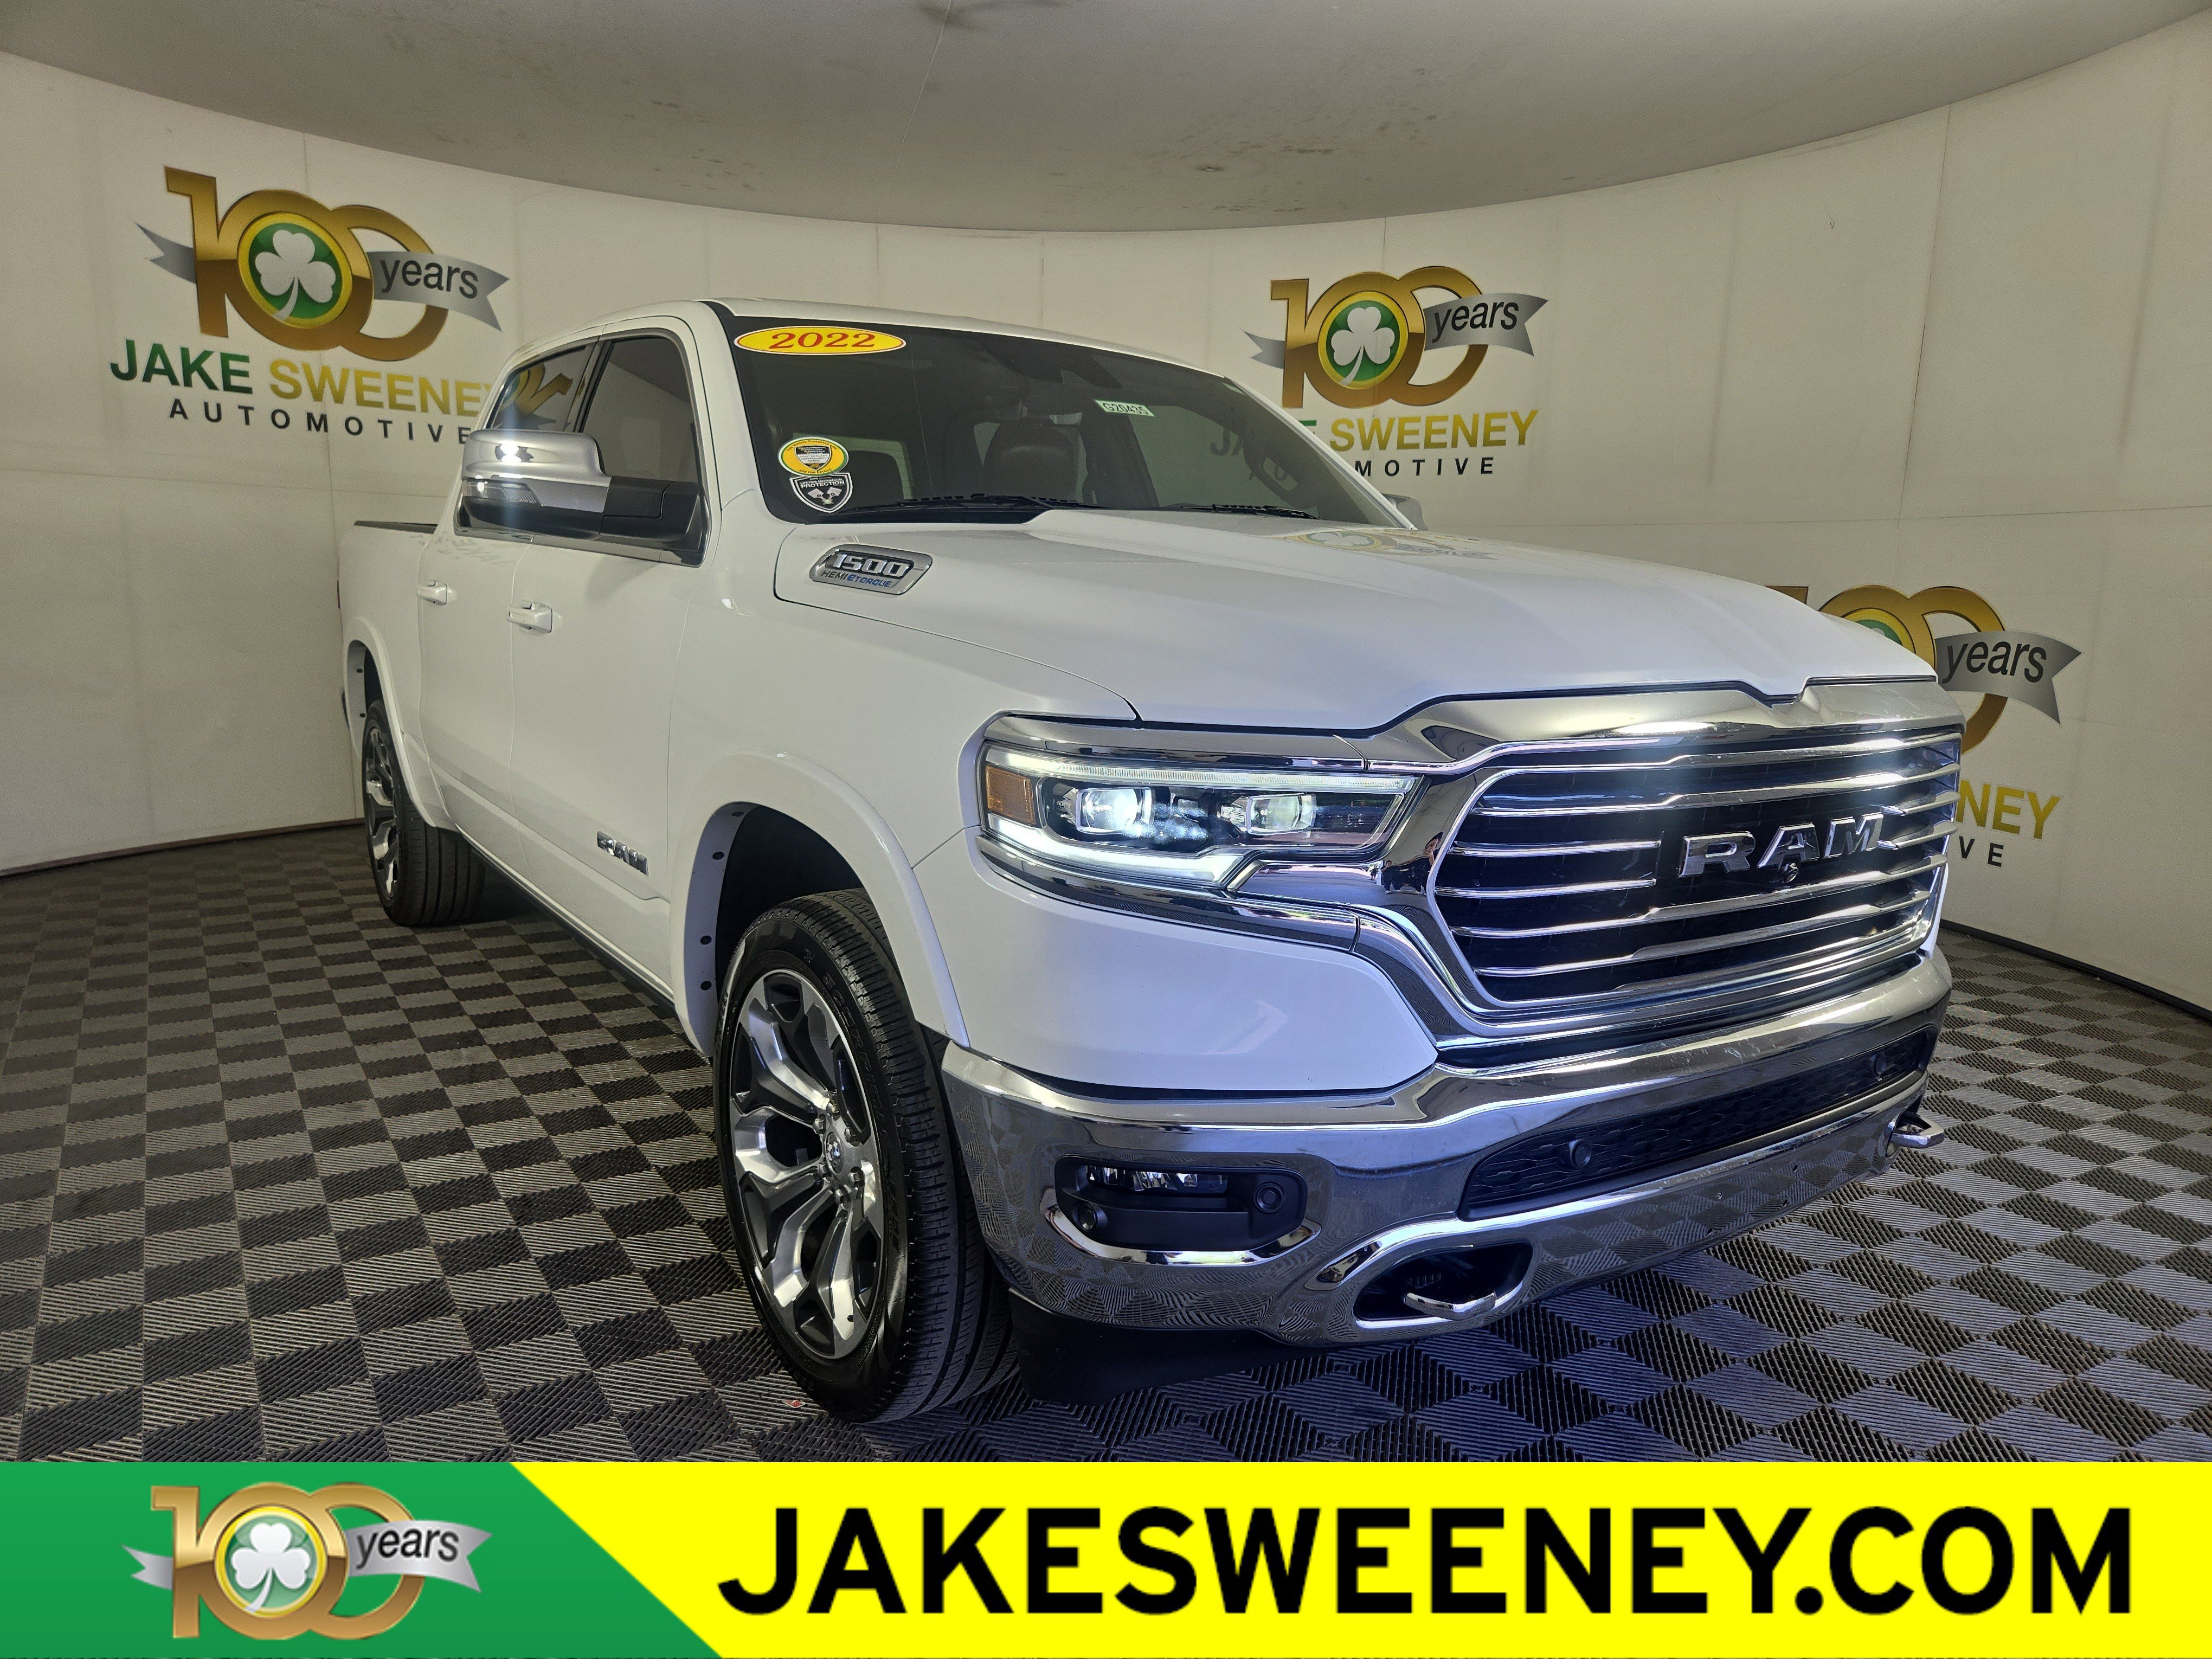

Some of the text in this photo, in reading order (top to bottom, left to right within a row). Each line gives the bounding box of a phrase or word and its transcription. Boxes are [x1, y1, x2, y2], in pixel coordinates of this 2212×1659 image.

[379, 258, 479, 299] years
[1431, 301, 1519, 344] years
[768, 332, 876, 349] 2022
[110, 339, 491, 417] JAKE SWEENE
[1103, 403, 1148, 415] G20435
[1329, 410, 1539, 452] SWEENEY
[1355, 456, 1494, 477] MOTIVE
[801, 480, 845, 488] PROTECTION
[821, 570, 848, 580] HEMI
[833, 554, 909, 577] 1500
[1941, 640, 2047, 684] years
[1678, 812, 1885, 878] RAM
